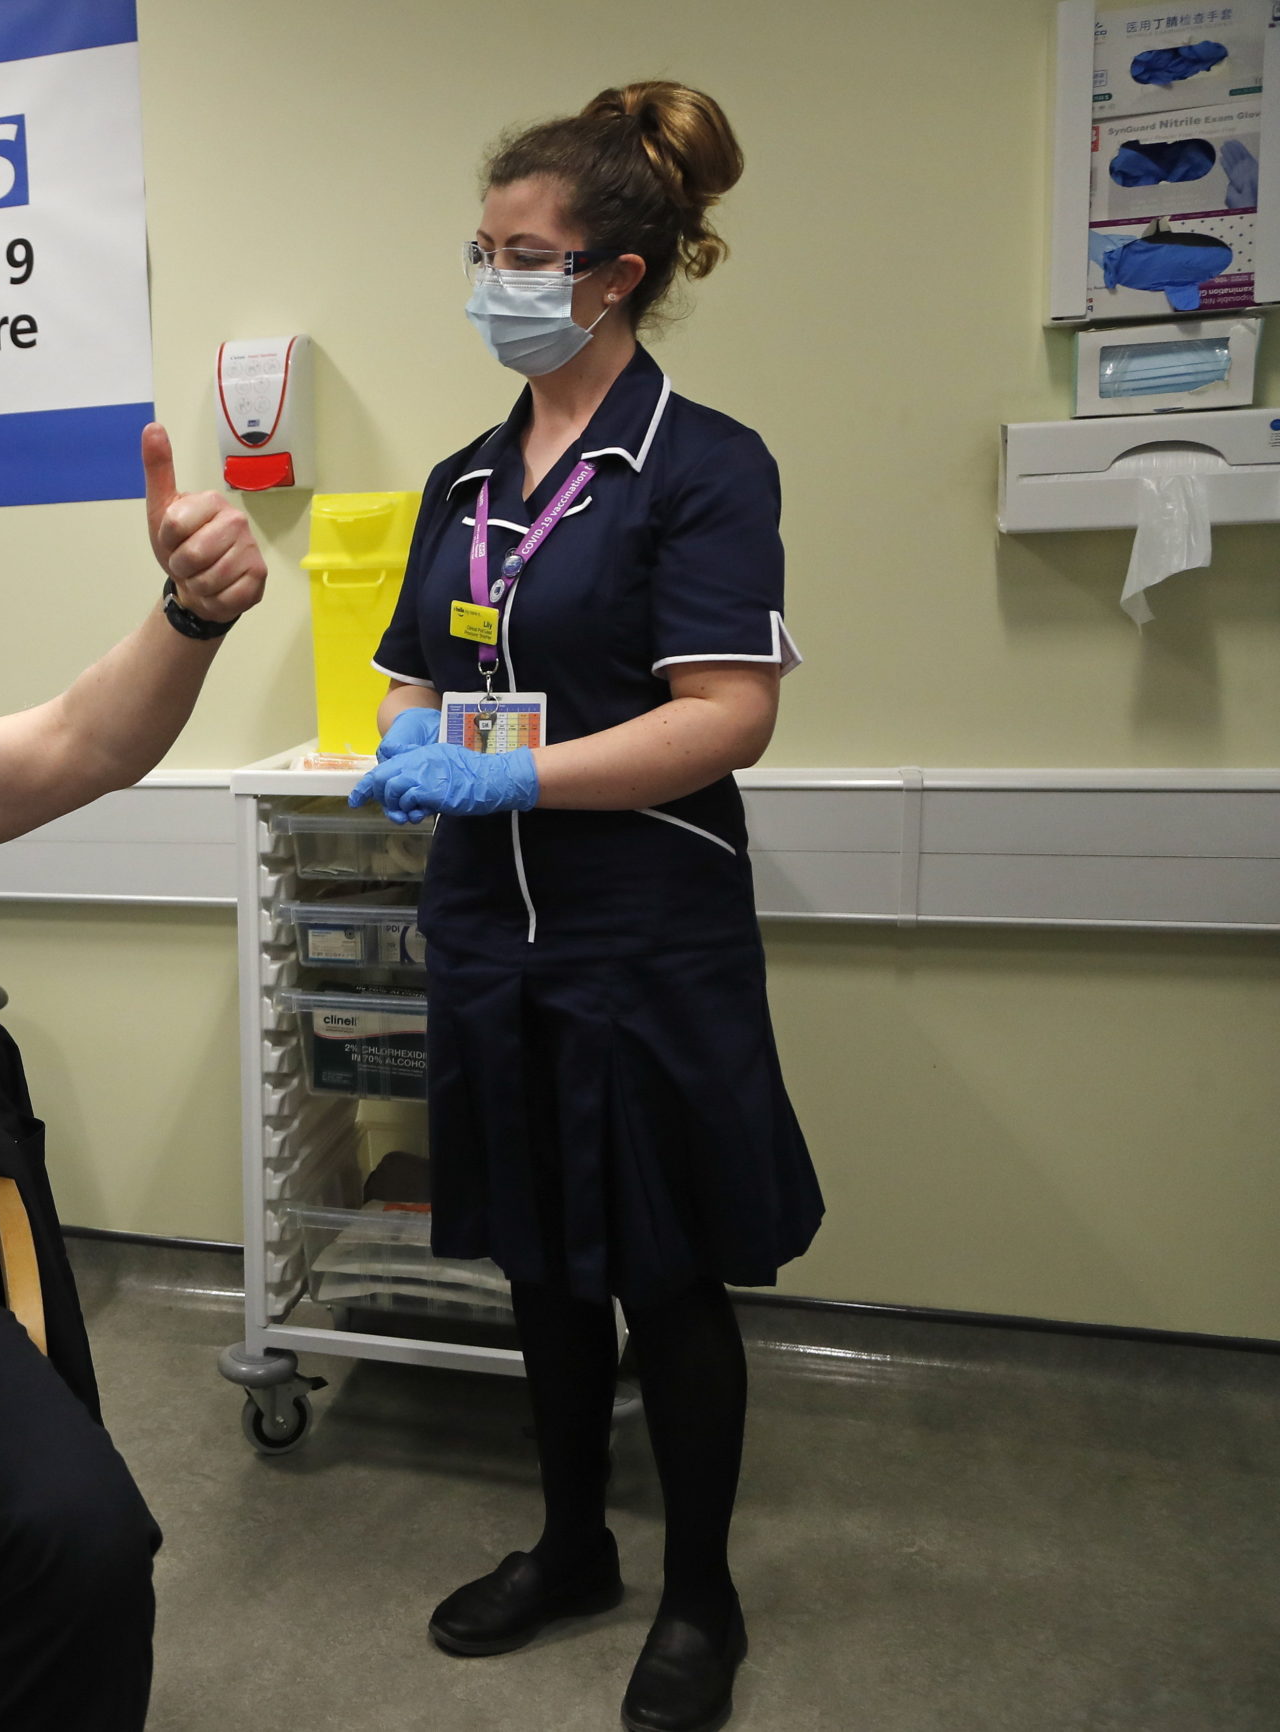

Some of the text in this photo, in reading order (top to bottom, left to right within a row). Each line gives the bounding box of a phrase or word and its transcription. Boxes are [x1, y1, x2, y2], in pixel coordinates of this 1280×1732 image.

[1159, 115, 1202, 130] Nitrile
[1204, 114, 1234, 124] Exam
[521, 516, 553, 555] COVID-19
[550, 470, 589, 517] vaccination
[323, 1014, 357, 1027] clinell
[344, 1043, 359, 1053] 2%
[351, 1053, 361, 1062] IN
[362, 1054, 383, 1065] 70%
